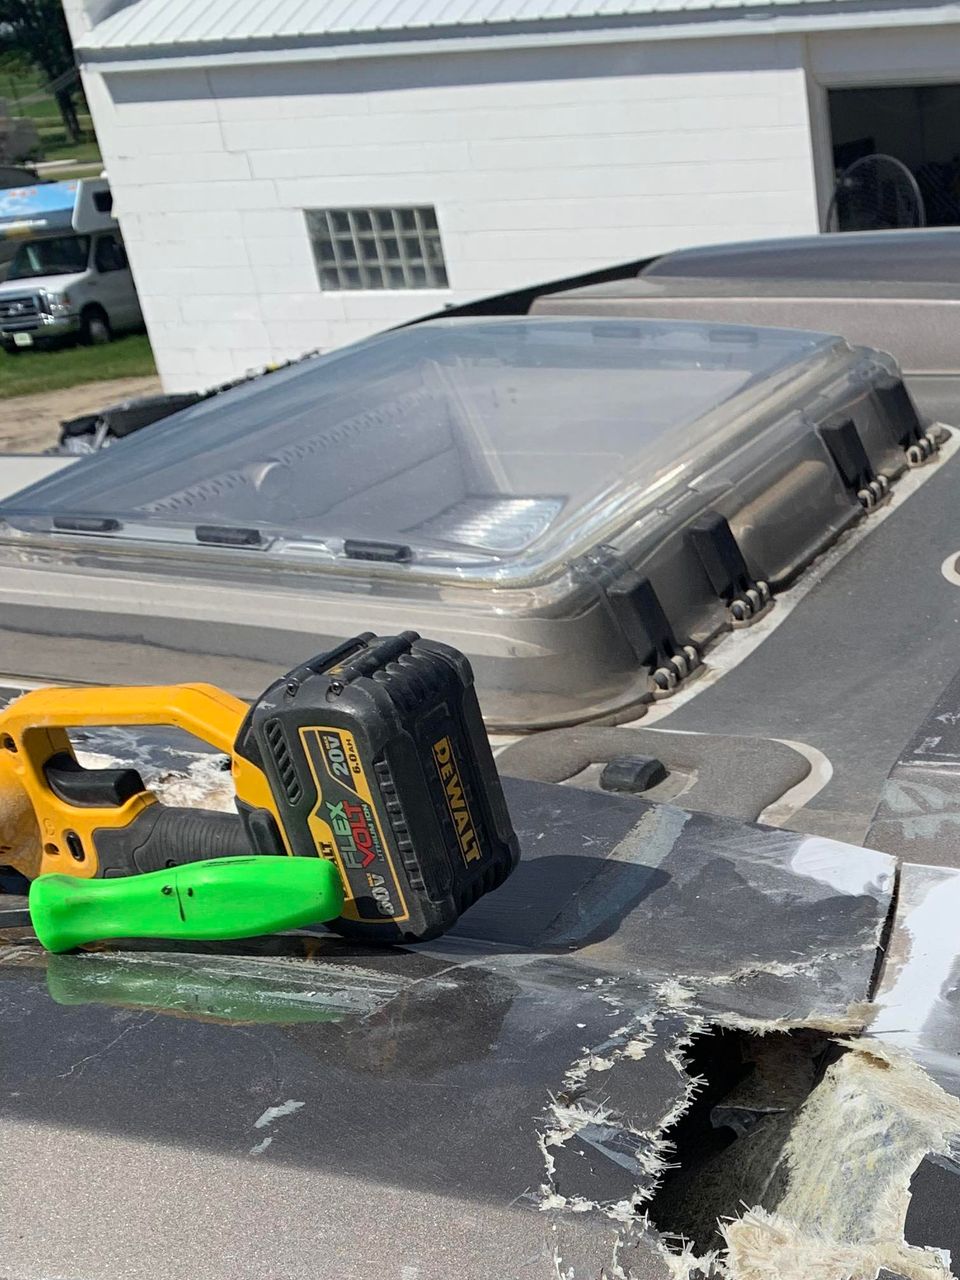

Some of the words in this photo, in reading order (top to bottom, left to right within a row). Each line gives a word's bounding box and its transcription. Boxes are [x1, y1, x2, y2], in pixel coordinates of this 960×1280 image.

[328, 735, 350, 777] 20V
[325, 800, 363, 869] FLEX
[342, 799, 376, 868] VOLT
[431, 738, 482, 863] DEWALT
